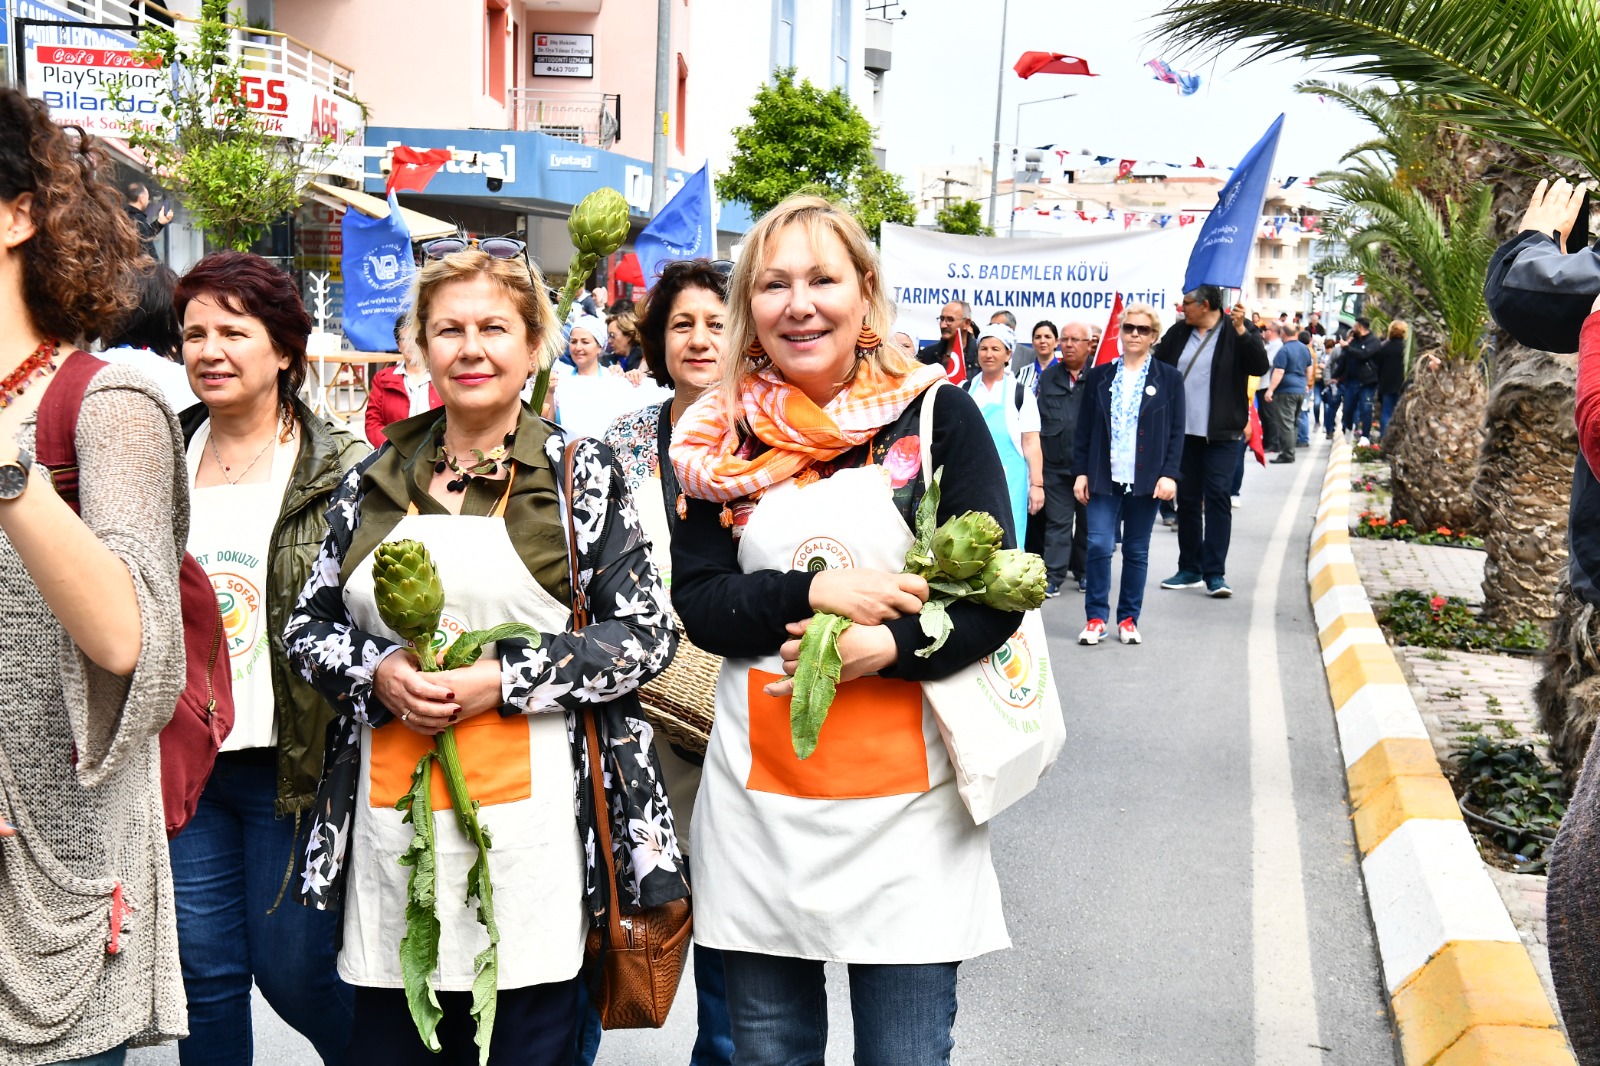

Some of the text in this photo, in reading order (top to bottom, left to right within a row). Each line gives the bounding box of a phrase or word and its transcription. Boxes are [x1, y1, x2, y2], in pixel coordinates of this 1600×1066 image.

[53, 49, 95, 64] Cafe
[44, 66, 158, 89] PlayStation
[43, 91, 157, 113] Bilardo
[311, 94, 338, 143] AGS
[948, 261, 1108, 281] S.S. BADEMLER KÖYÜ
[974, 289, 1056, 308] KALKINMA
[217, 551, 259, 569] DOKUZU
[797, 542, 849, 569] DOĞAL SOFRA
[227, 580, 258, 613] SOFRA
[1009, 686, 1031, 701] ULA
